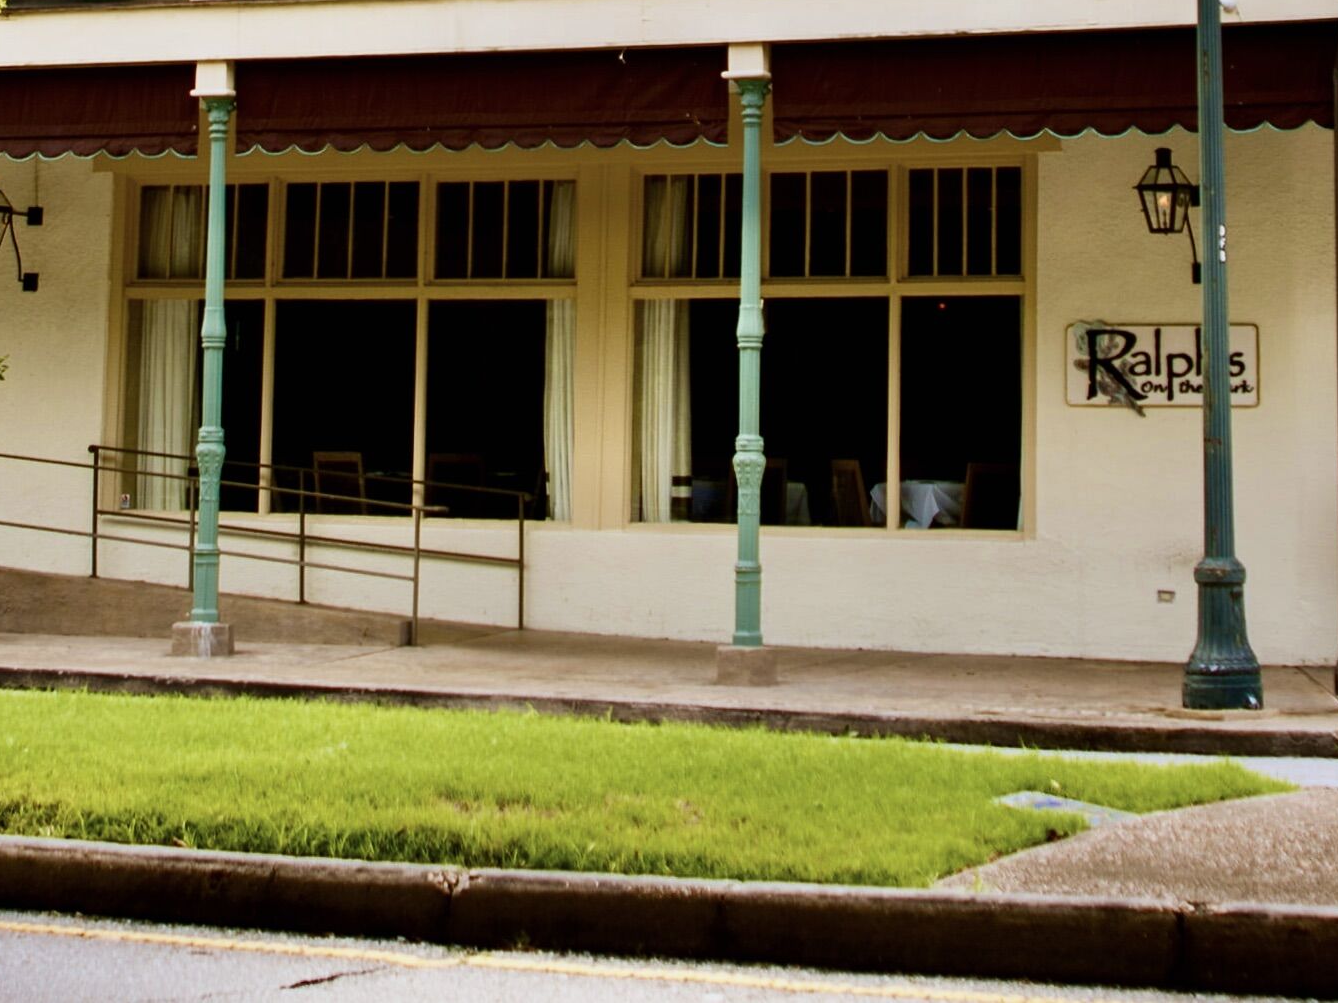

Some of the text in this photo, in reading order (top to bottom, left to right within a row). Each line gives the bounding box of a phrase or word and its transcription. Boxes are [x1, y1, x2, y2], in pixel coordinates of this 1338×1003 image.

[1086, 328, 1246, 401] Ralphs
[1141, 381, 1168, 393] On
[1179, 380, 1204, 393] the
